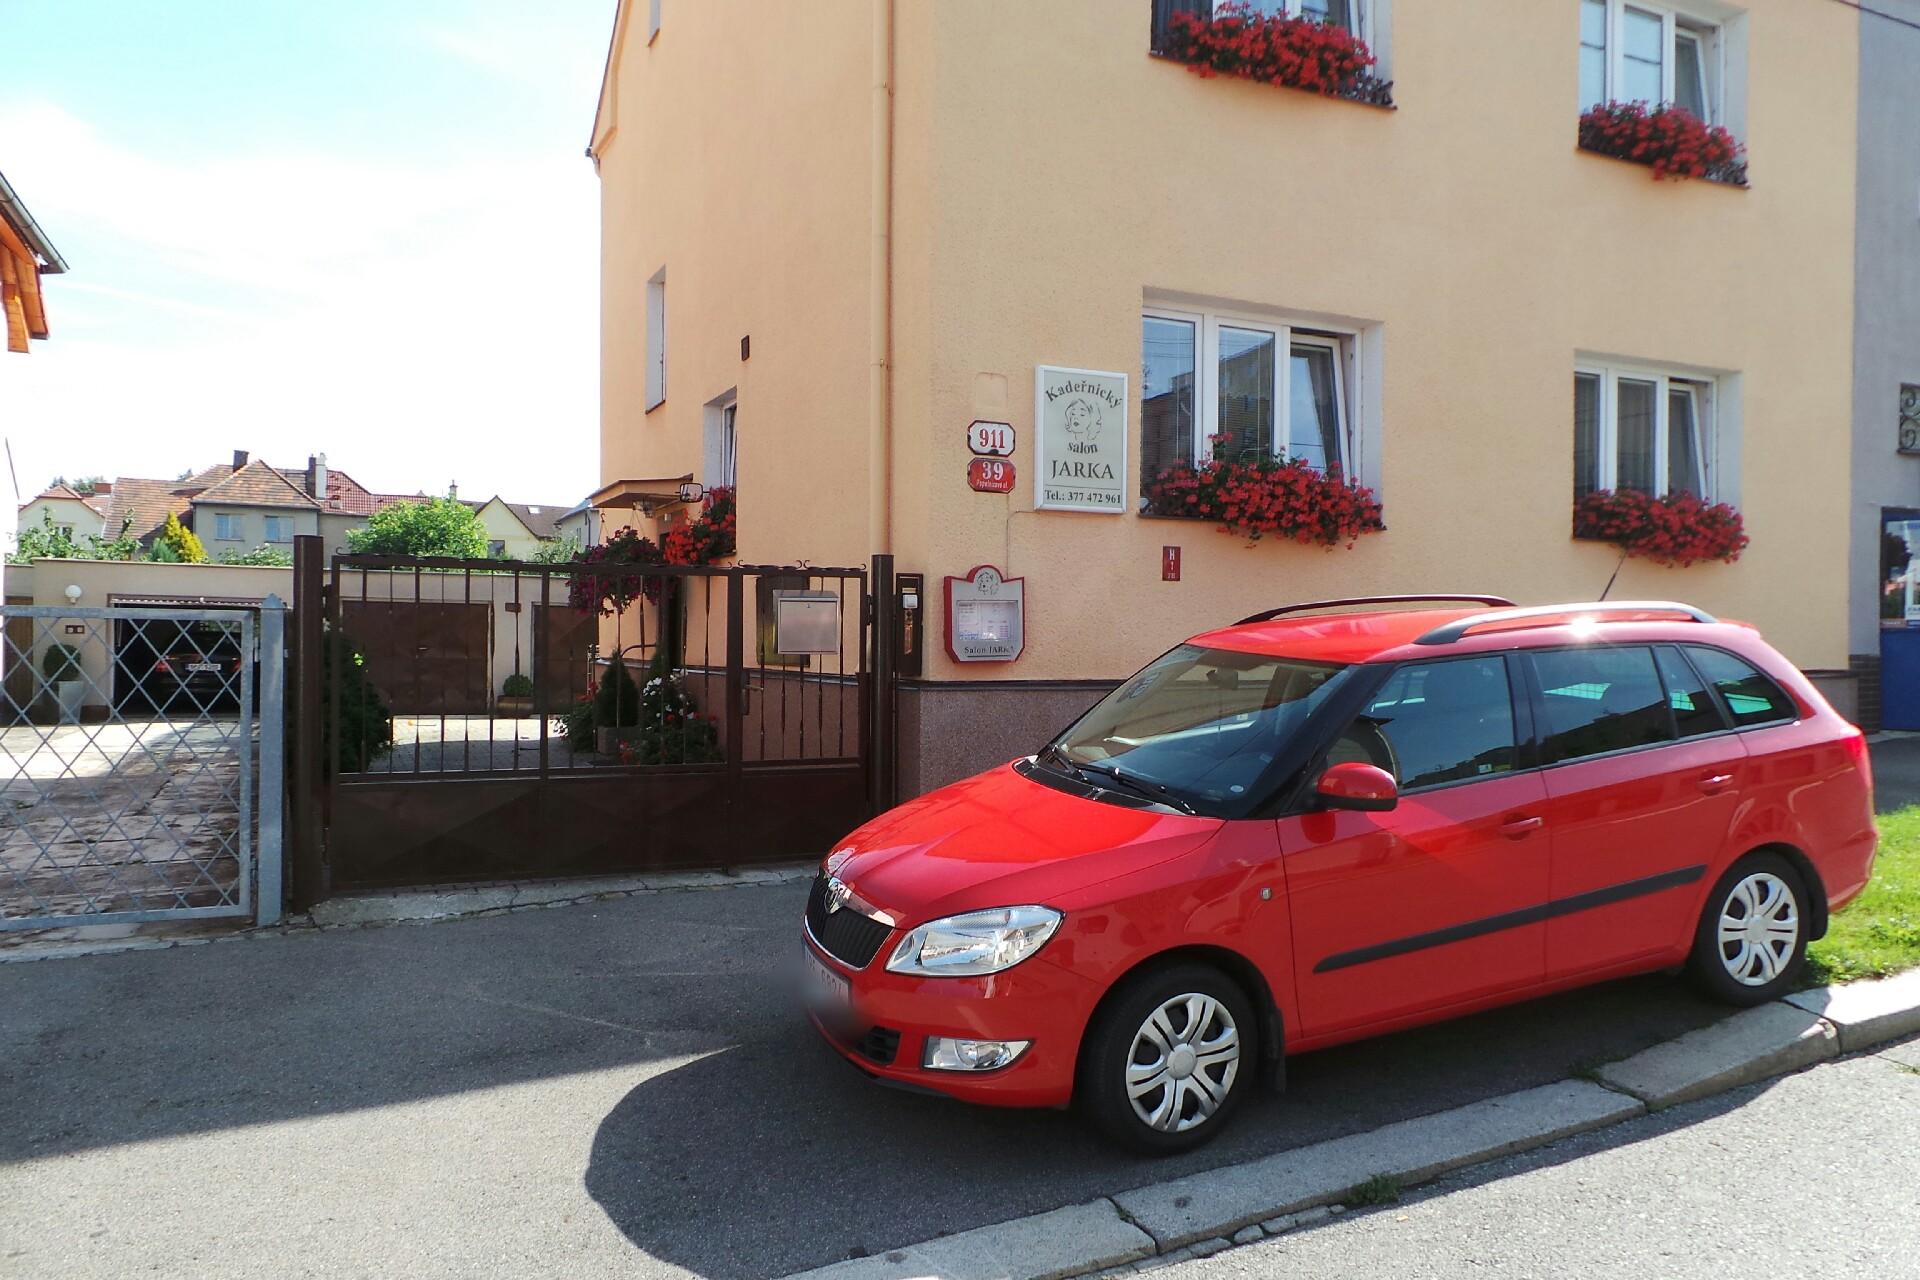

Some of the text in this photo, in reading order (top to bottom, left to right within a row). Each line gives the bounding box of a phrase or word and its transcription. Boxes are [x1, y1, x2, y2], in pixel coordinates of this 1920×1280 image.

[1045, 380, 1122, 408] Kadeřnický
[979, 428, 1005, 448] 911
[1067, 441, 1098, 454] salon
[982, 461, 1004, 481] 39
[1051, 459, 1114, 479] JARKA
[1045, 489, 1121, 504] Tel.: 377 472 961
